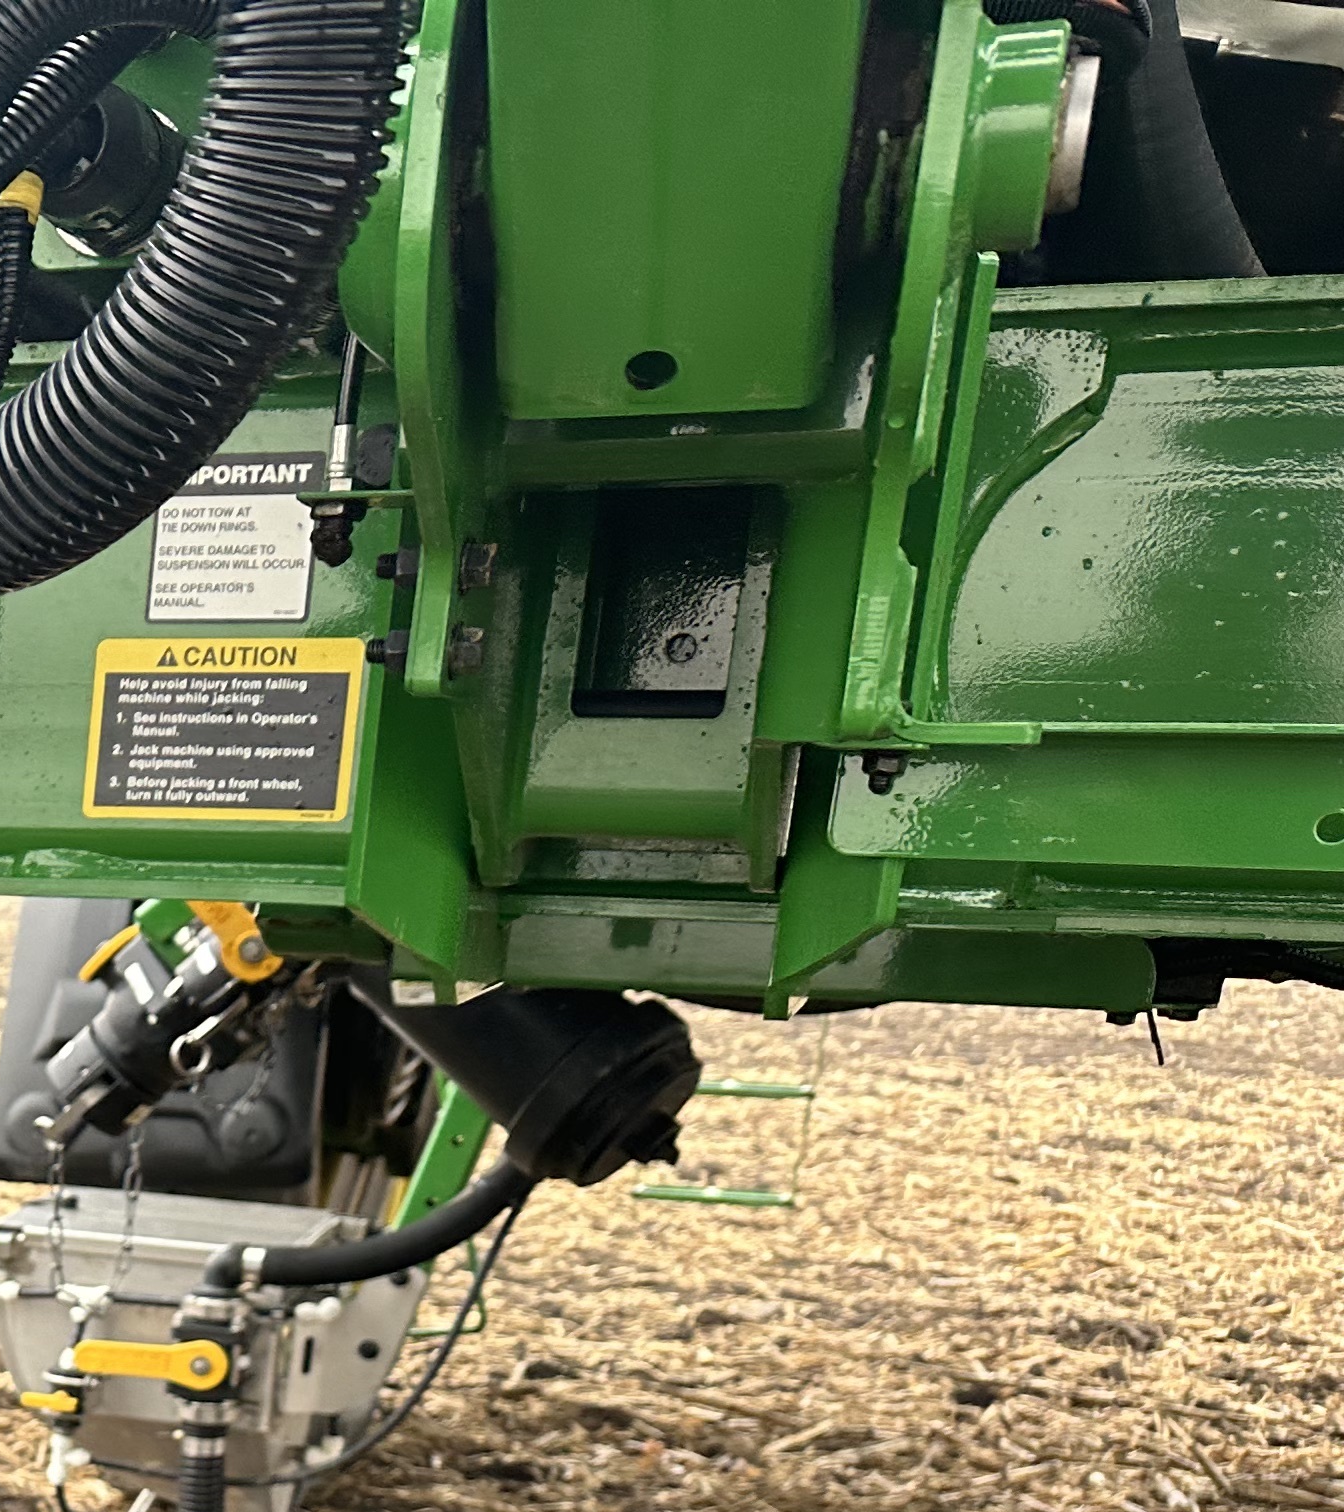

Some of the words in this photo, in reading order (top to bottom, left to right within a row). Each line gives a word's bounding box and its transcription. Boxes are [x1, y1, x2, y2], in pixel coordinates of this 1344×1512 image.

[162, 508, 179, 518] DO
[182, 508, 208, 518] NOT
[209, 507, 234, 518] TOW
[236, 507, 251, 517] AT
[162, 523, 178, 532] TIE
[181, 522, 216, 532] DOWN
[219, 522, 257, 531] RINGS.
[159, 546, 204, 556] SEVERE
[208, 546, 259, 555] DAMAGE
[260, 545, 276, 555] TO
[158, 560, 230, 570] SUSPENSION
[232, 559, 259, 569] WILL
[263, 559, 305, 569] OCCUR.
[155, 583, 177, 593] SEE
[180, 582, 255, 593] OPERATOR'S
[154, 598, 204, 607] MANUAL.
[184, 646, 297, 666] CAUTION
[120, 678, 148, 690] Help
[152, 678, 187, 690] avoid
[190, 678, 227, 692] injury
[232, 678, 262, 690] from
[266, 678, 308, 692] falling
[118, 692, 172, 703] machine
[176, 692, 210, 703] while
[212, 692, 264, 706] jacking:
[116, 713, 126, 724] 1.
[133, 712, 156, 723] See
[160, 712, 232, 724] instructions
[236, 713, 248, 724] in
[252, 713, 318, 726] Operator's
[132, 726, 180, 736] Manual.
[112, 744, 124, 756] 2.
[130, 745, 159, 756] Jack
[162, 745, 213, 756] machine
[217, 746, 251, 758] using
[254, 746, 314, 759] approved
[129, 759, 196, 770] equipment.
[110, 776, 121, 788] 3.
[126, 776, 168, 788] Before
[170, 777, 214, 790] jacking
[218, 780, 224, 789] a
[229, 778, 259, 790] front
[262, 779, 302, 792] wheel,
[126, 791, 152, 801] turn
[154, 791, 164, 801] it
[166, 791, 192, 803] fully
[196, 792, 249, 802] outward.
